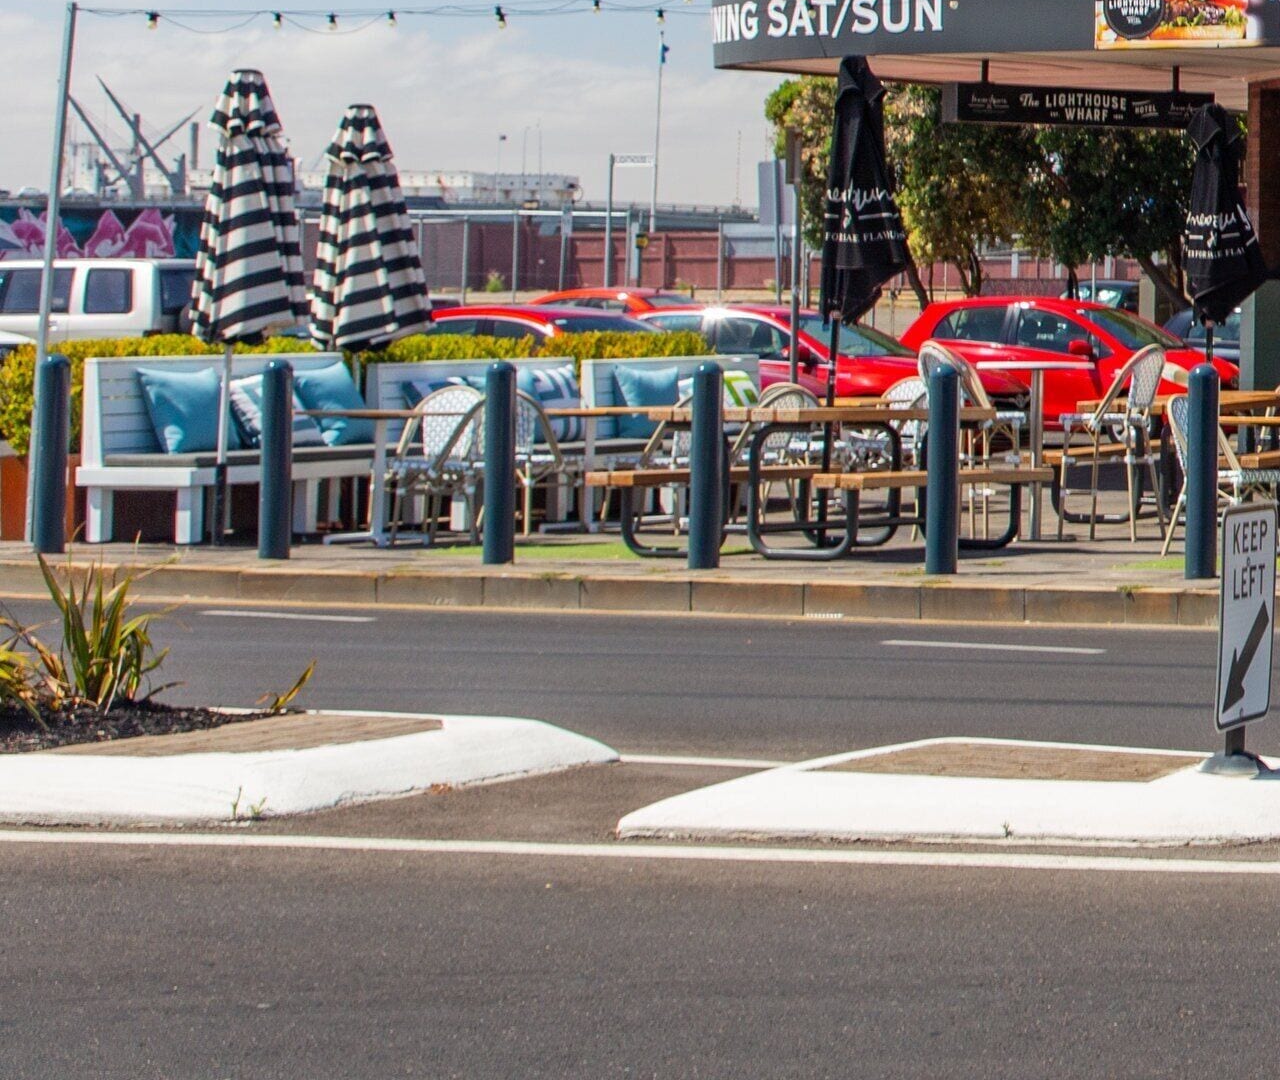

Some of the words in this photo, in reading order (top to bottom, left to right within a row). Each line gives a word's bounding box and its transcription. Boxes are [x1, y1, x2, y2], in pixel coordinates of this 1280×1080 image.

[1121, 7, 1149, 16] WHARF
[1019, 93, 1040, 108] The
[1045, 92, 1127, 111] LIGHTHOUSE
[1134, 104, 1157, 114] HOTEL
[1065, 107, 1109, 121] WHARF
[1233, 520, 1268, 555] KEEP
[1233, 564, 1266, 601] LEFT
